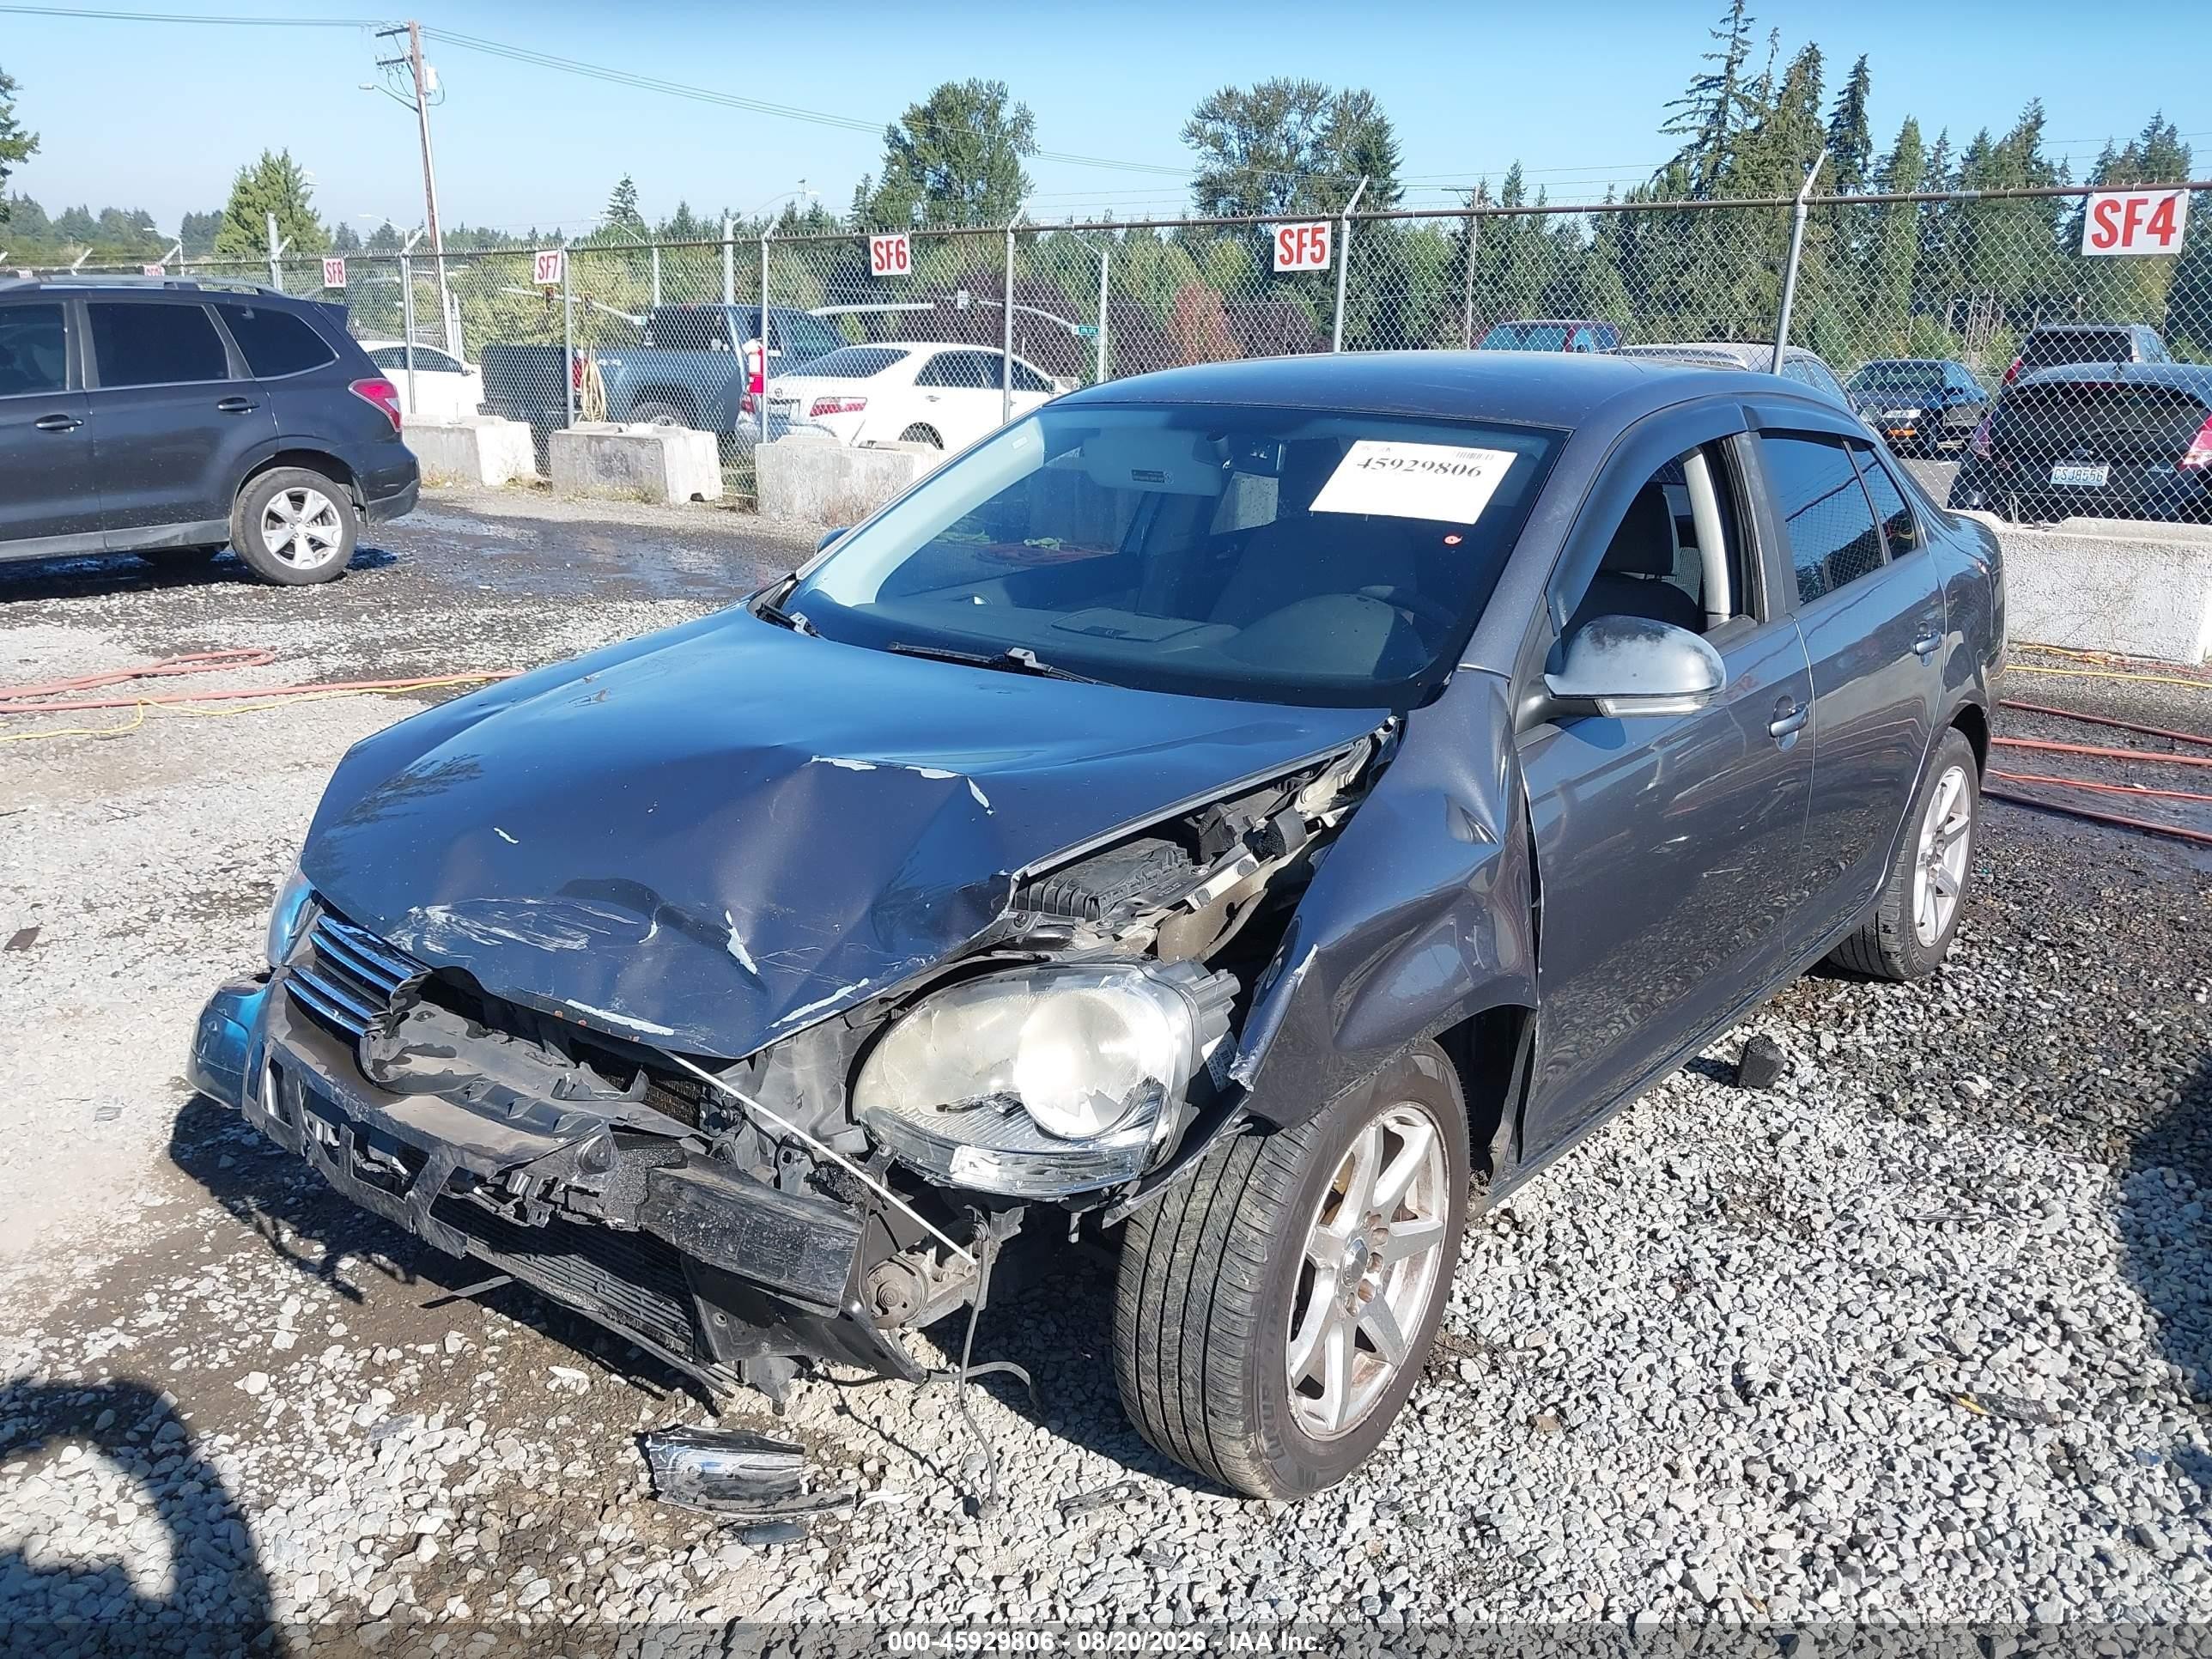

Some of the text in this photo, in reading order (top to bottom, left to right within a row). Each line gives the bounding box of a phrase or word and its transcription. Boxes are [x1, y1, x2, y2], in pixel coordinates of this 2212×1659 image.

[2092, 197, 2177, 249] SF4
[873, 239, 908, 271] SF6
[1279, 227, 1326, 265] SF5
[325, 261, 343, 283] SF8
[538, 254, 558, 280] SF7
[1357, 457, 1482, 477] 45929806
